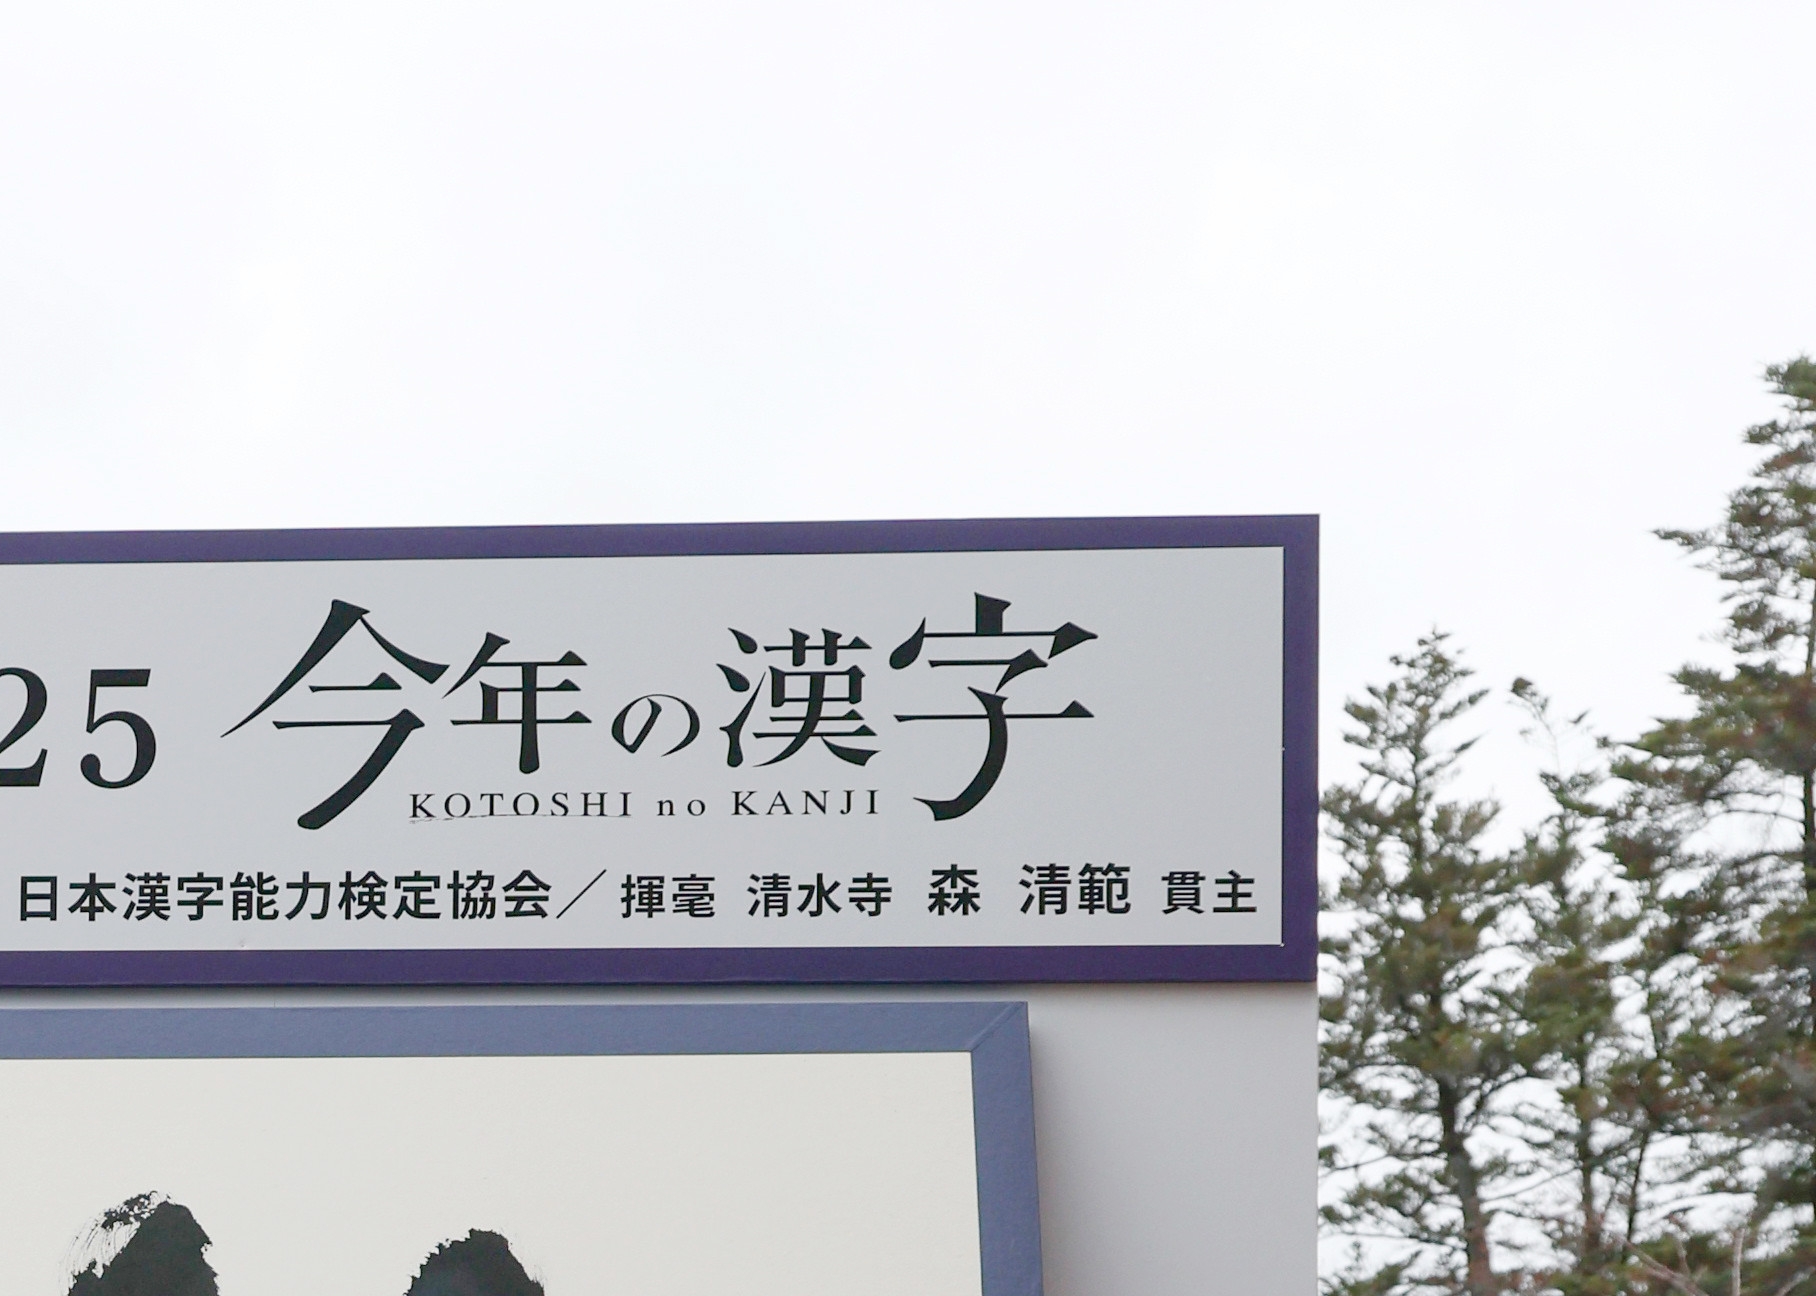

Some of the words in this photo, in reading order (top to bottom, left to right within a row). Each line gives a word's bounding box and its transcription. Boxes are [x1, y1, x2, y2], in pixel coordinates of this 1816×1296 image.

[220, 592, 1099, 831] 今年の漢字
[409, 792, 633, 819] KOTOSHI
[657, 799, 706, 816] no
[732, 789, 880, 816] KANJI
[747, 872, 893, 918] 清水寺
[927, 863, 981, 916] 森
[1018, 862, 1131, 916] 清範
[1161, 869, 1257, 915] 貫主
